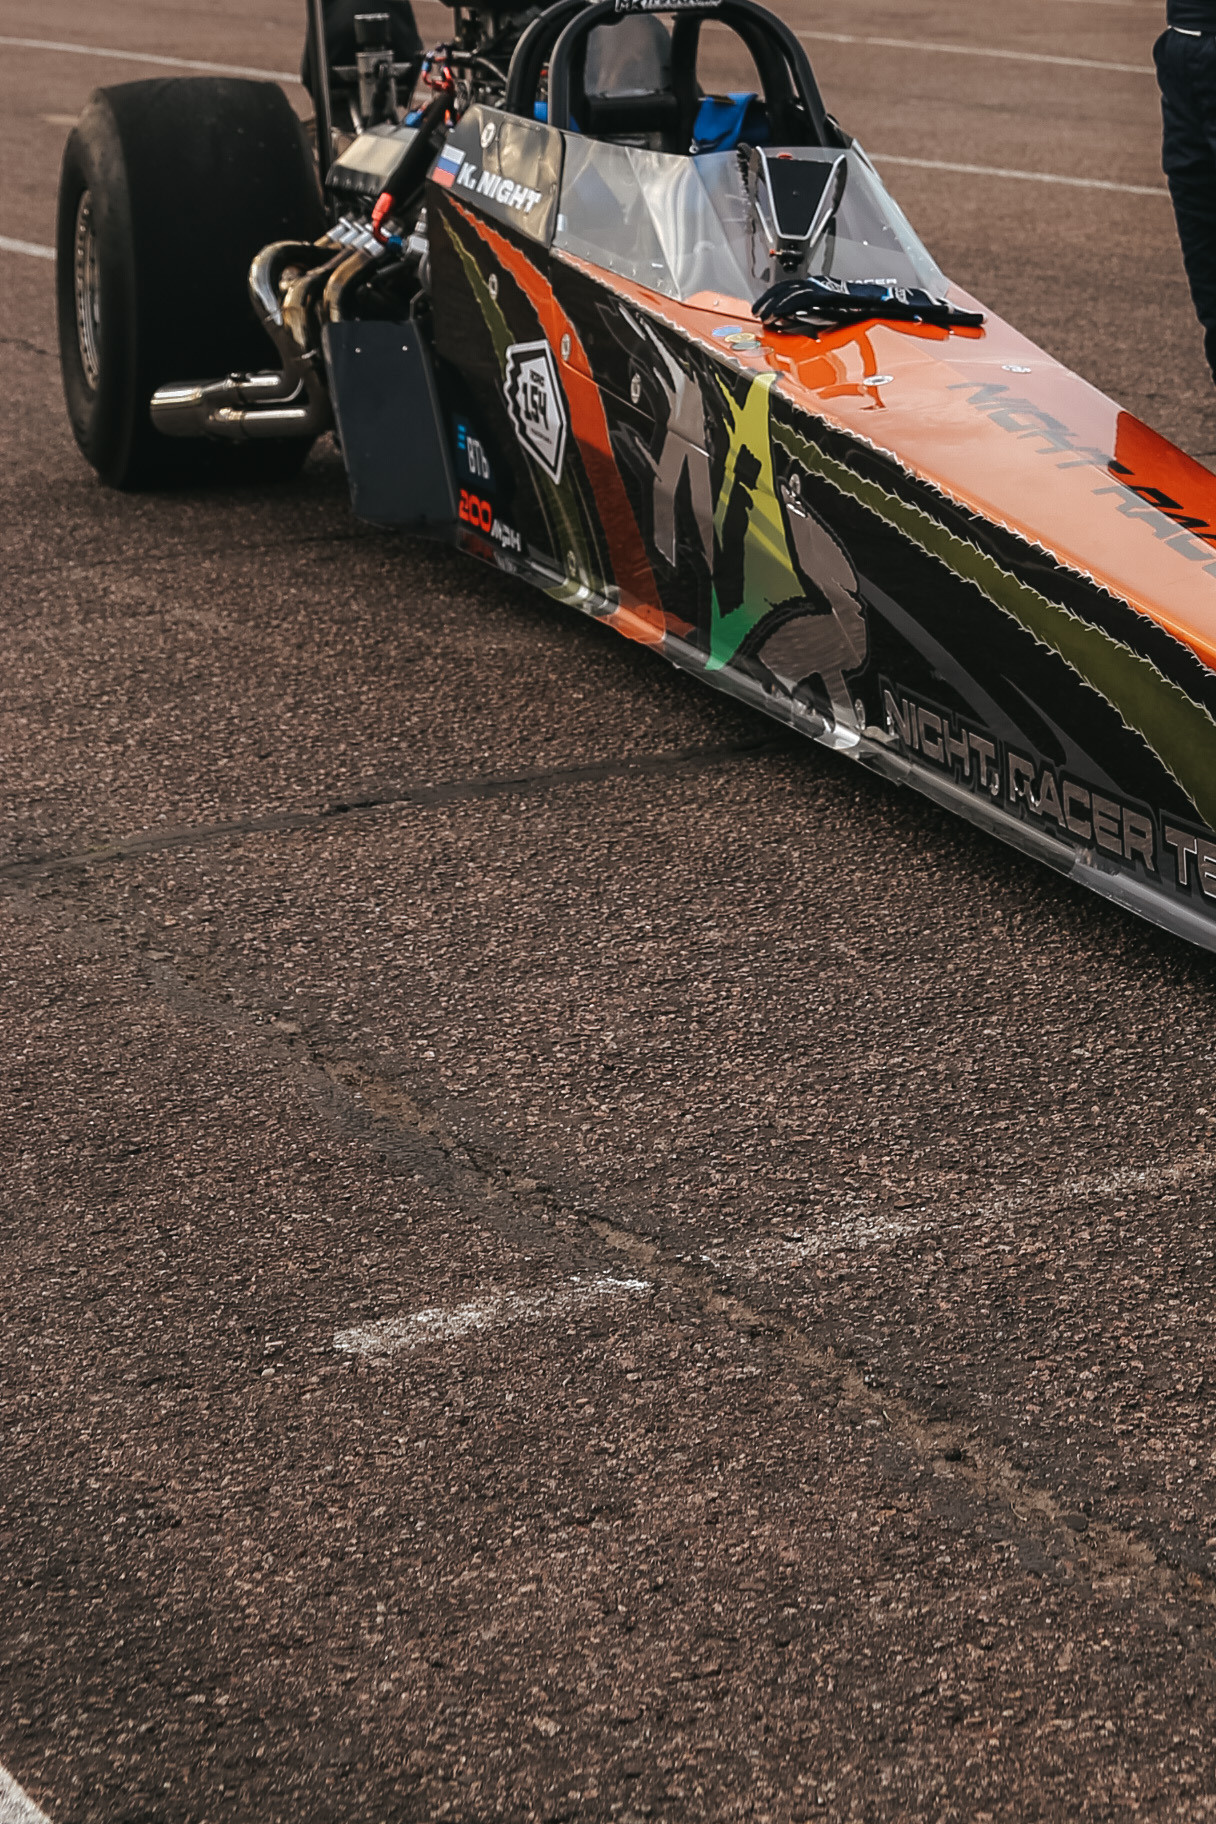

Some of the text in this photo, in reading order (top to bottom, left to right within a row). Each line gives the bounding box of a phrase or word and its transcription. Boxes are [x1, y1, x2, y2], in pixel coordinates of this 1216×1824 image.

[456, 161, 543, 213] K. NIGHT
[523, 382, 550, 431] 154
[945, 382, 1136, 477] NIGHT
[883, 688, 997, 788] NIGHT
[1007, 751, 1156, 873] RACER
